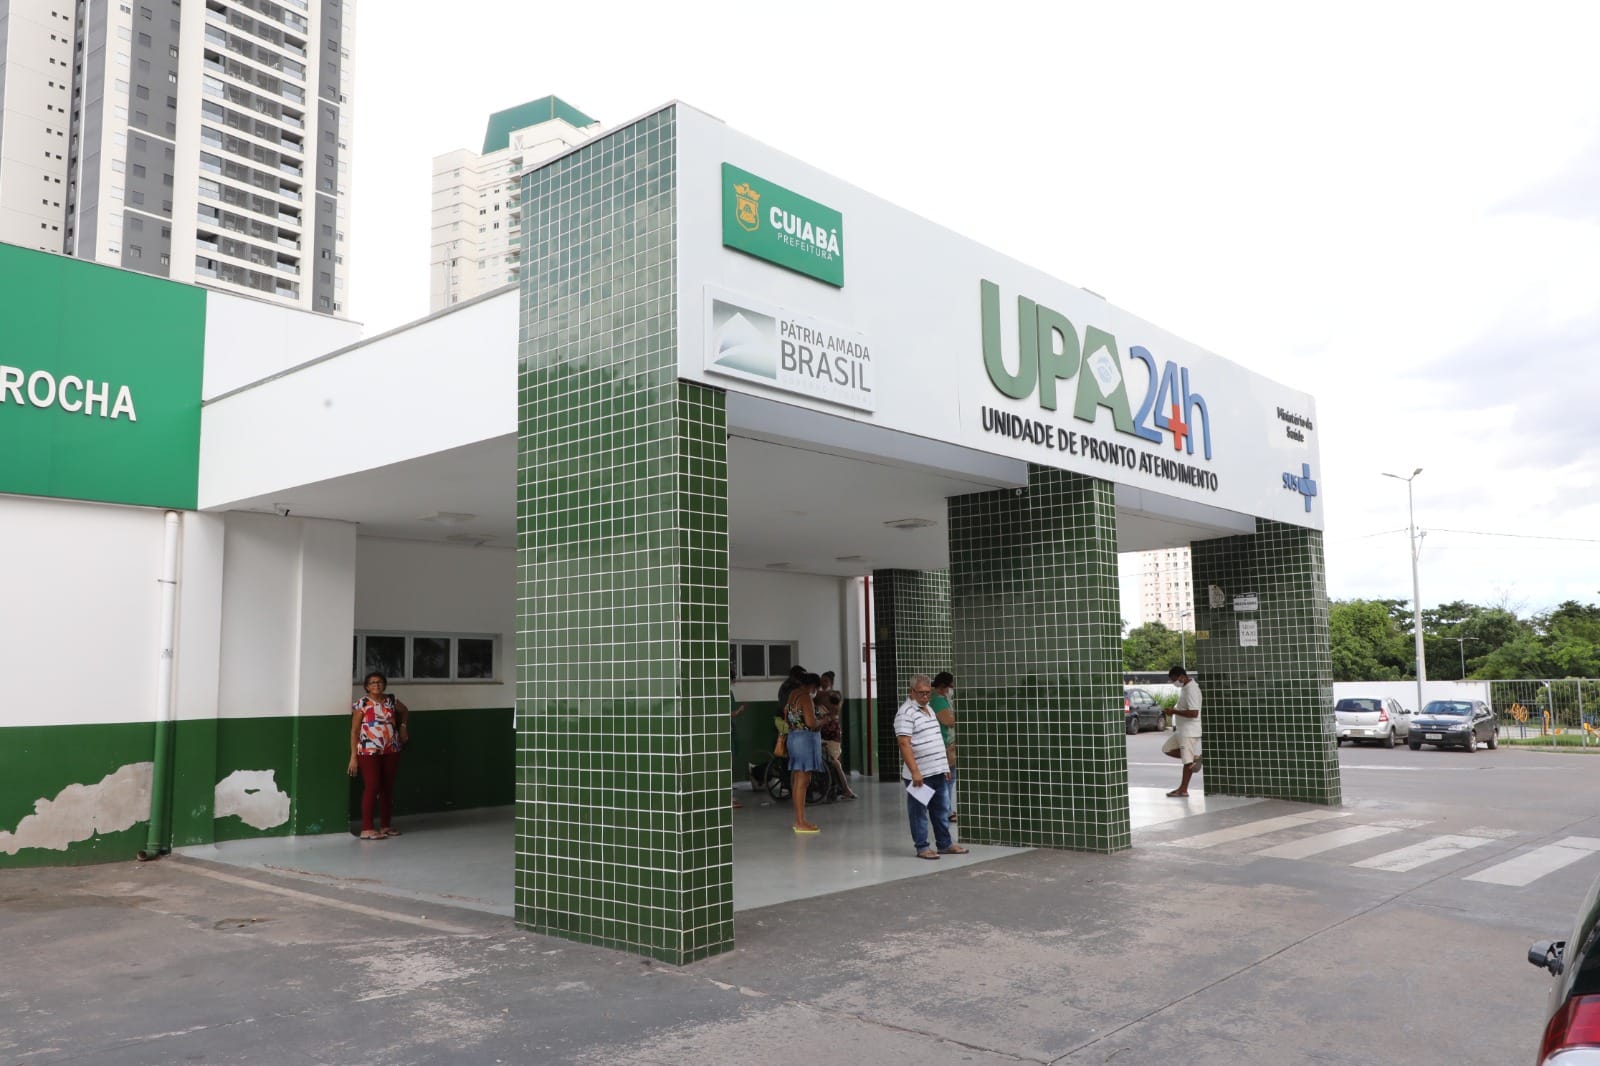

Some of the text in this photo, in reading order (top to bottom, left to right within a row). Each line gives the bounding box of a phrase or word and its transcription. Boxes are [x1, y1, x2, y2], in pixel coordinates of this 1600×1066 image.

[770, 206, 840, 256] CUIABÁ
[777, 232, 833, 261] PREFEITURA
[781, 320, 871, 361] PÁTRIA AMADA
[781, 340, 871, 393] BRASIL
[0, 365, 137, 421] ROCHA
[982, 405, 1218, 491] UNIDADE DE PRONTO ATENDIMENTO
[1282, 472, 1298, 492] SUS
